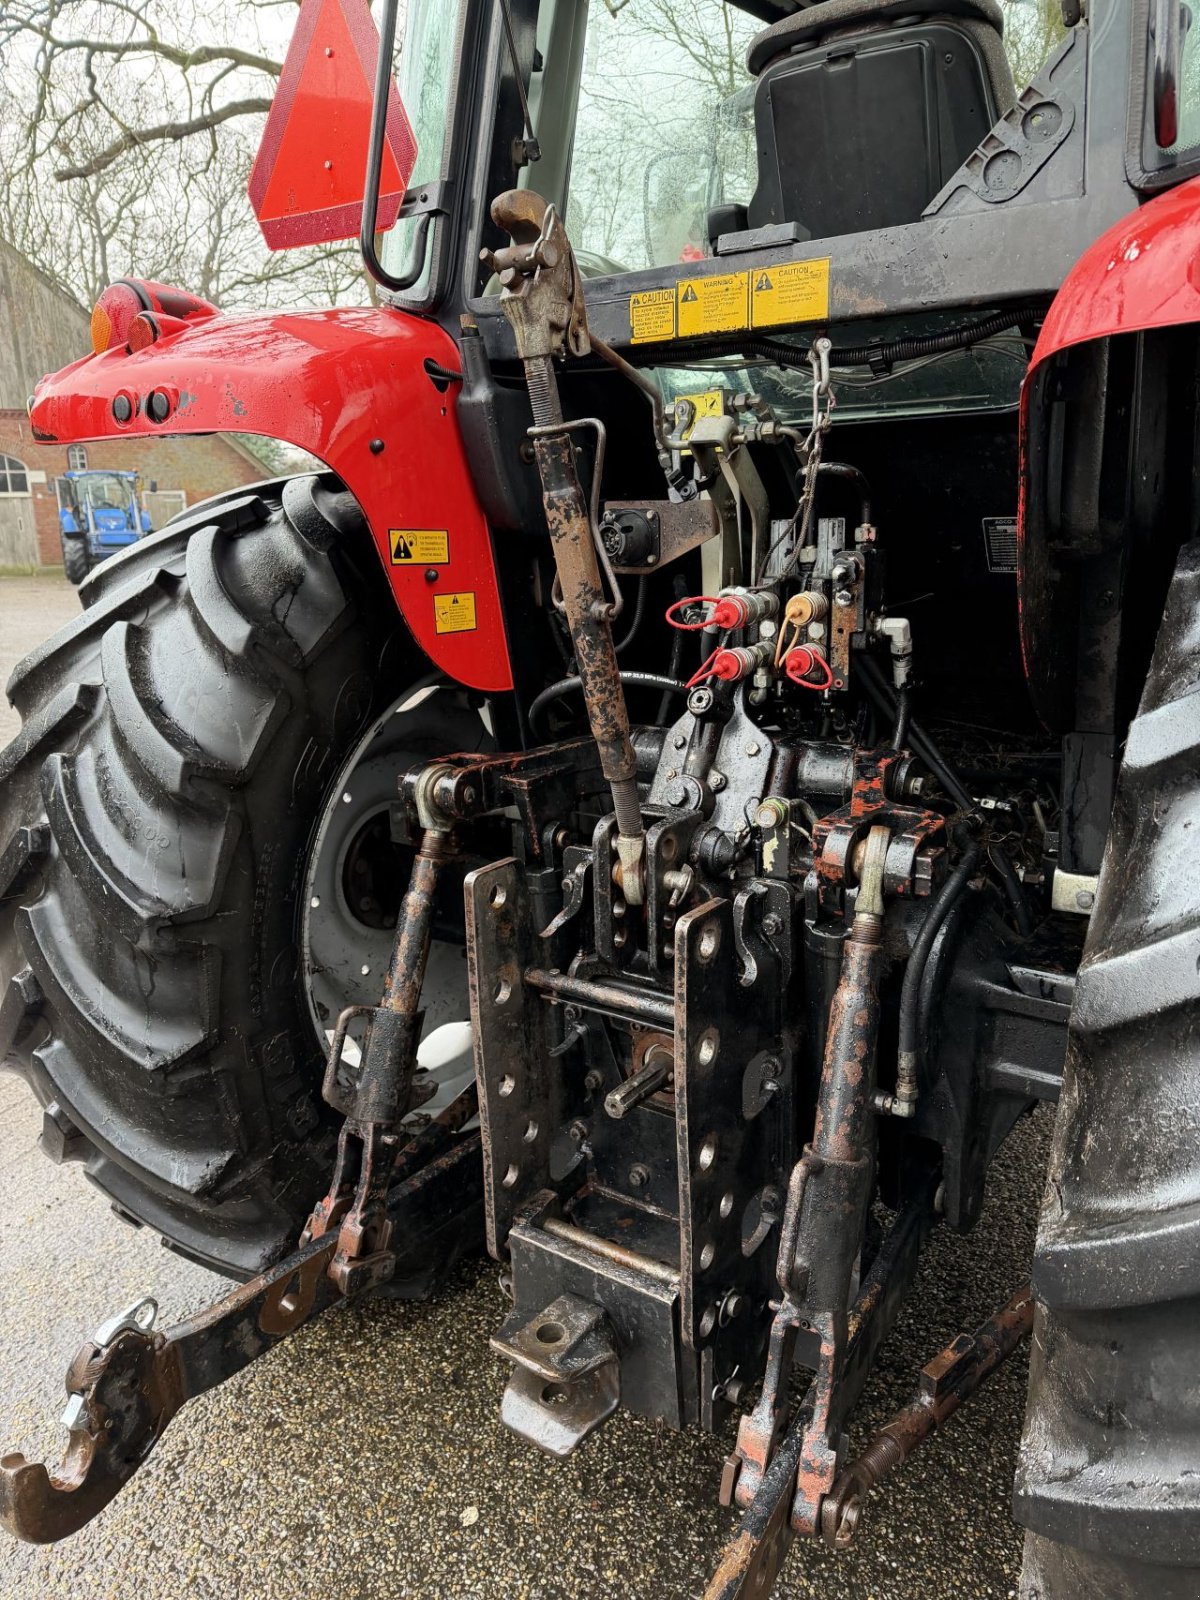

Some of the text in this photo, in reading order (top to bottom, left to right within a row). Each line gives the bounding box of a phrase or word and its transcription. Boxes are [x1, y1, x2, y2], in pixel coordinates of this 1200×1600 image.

[778, 266, 809, 277] CAUTION
[703, 278, 734, 289] WARNING
[641, 290, 674, 304] CAUTION
